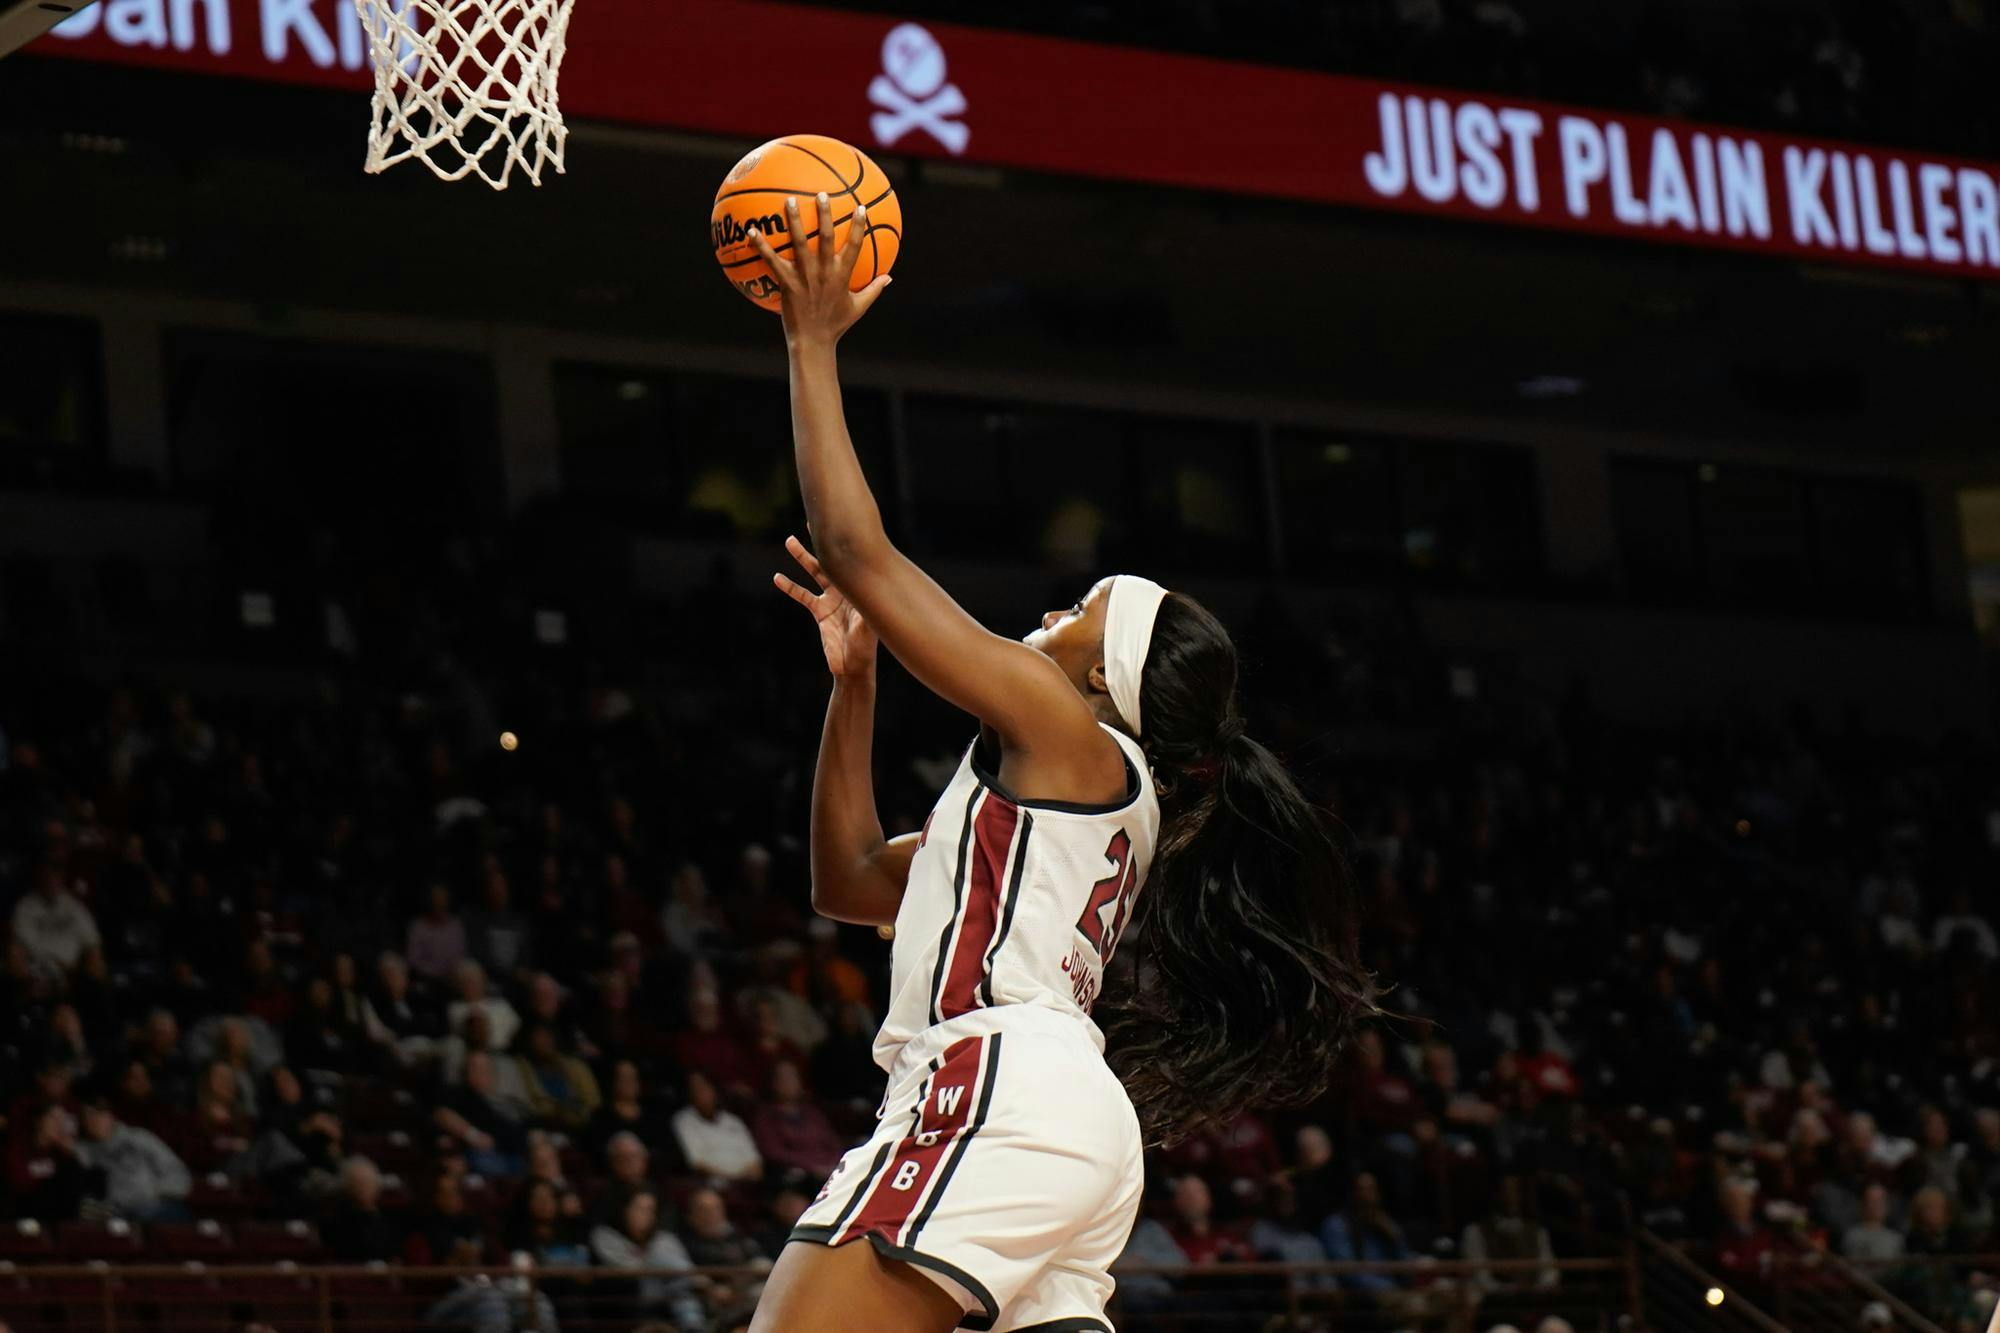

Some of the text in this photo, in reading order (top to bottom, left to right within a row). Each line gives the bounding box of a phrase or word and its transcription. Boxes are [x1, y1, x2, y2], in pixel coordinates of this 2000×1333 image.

[48, 0, 232, 55] an
[1363, 92, 2000, 268] JUST PLAIN KILLER
[1061, 945, 1096, 1017] JOHNSO
